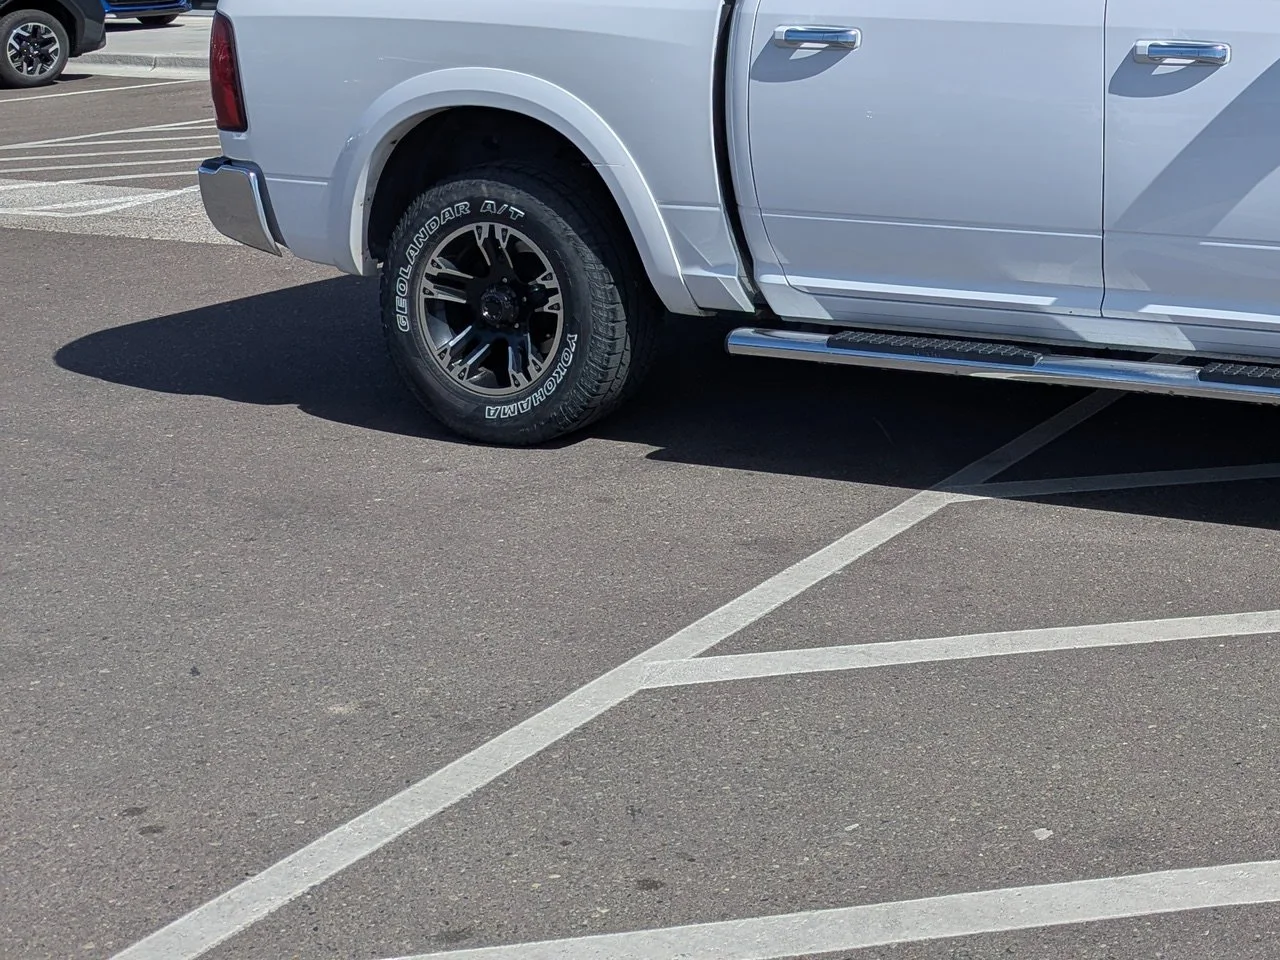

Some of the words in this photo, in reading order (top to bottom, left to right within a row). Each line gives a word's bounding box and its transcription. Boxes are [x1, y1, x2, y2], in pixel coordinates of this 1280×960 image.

[396, 201, 471, 332] GEOLANDAR
[480, 200, 525, 220] A/T
[485, 333, 578, 419] YOKOHAMA
